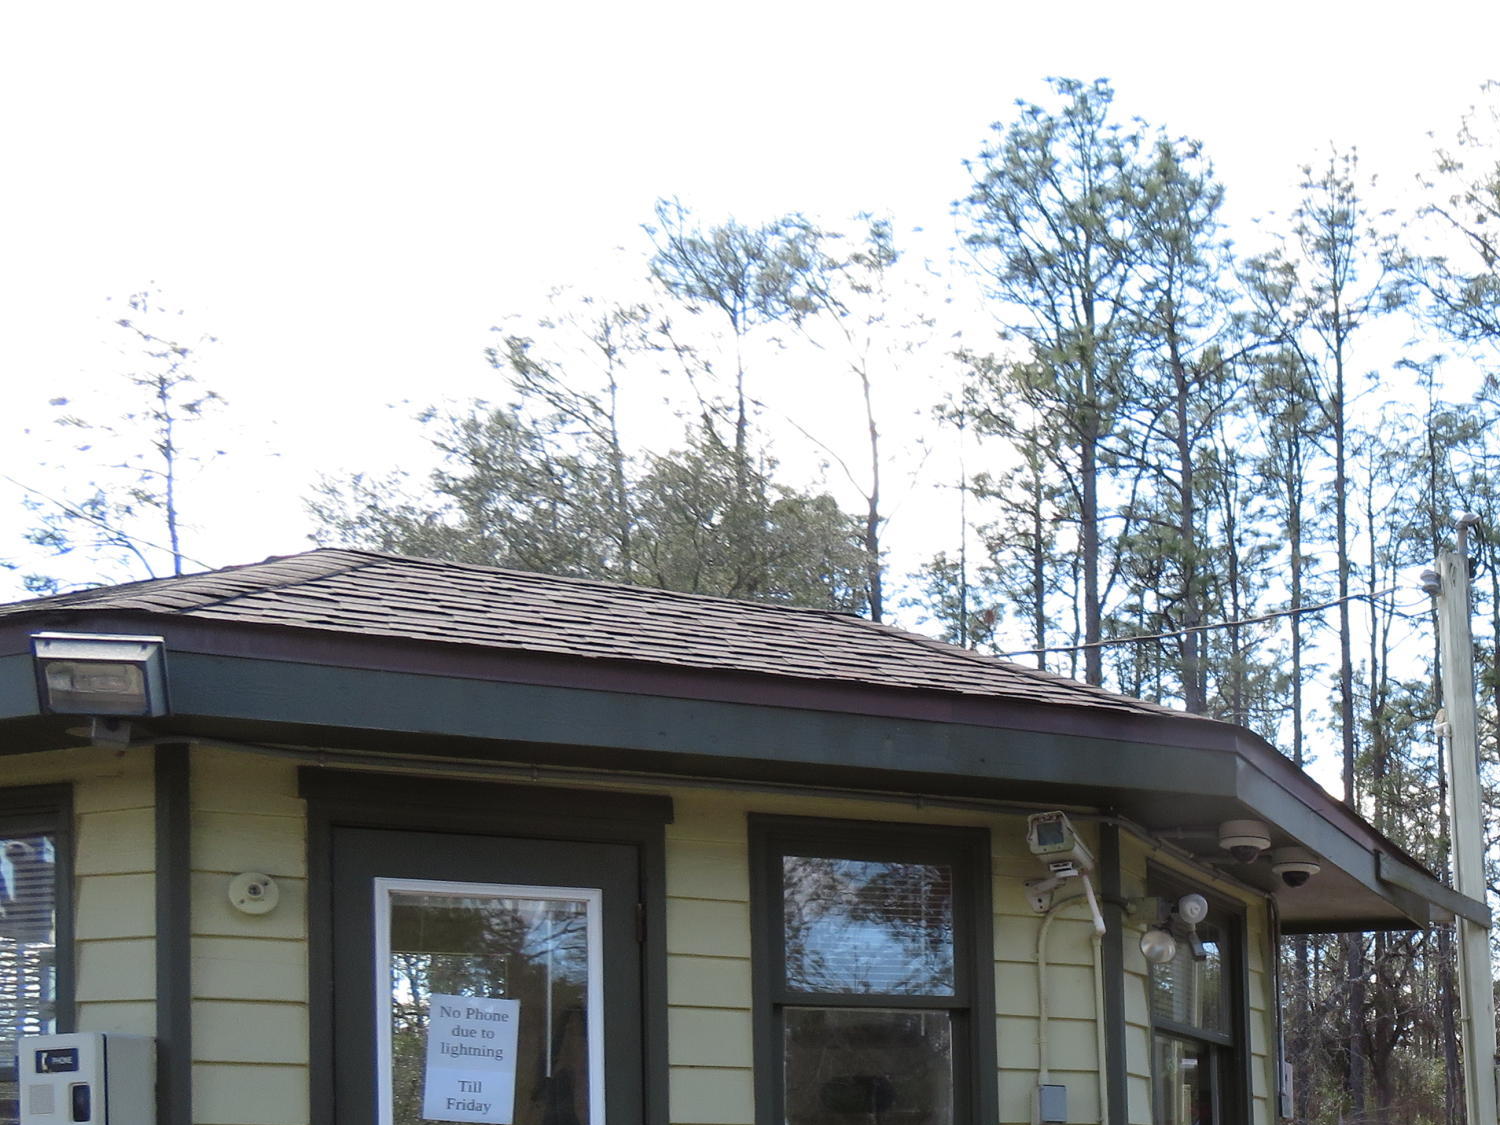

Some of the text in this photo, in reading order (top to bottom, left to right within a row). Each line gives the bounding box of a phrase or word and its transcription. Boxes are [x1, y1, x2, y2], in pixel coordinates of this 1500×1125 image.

[440, 1006, 509, 1023] No Phone
[451, 1024, 495, 1040] due to
[440, 1042, 503, 1062] lightning
[458, 1080, 482, 1093] Till
[446, 1098, 492, 1115] Friday
